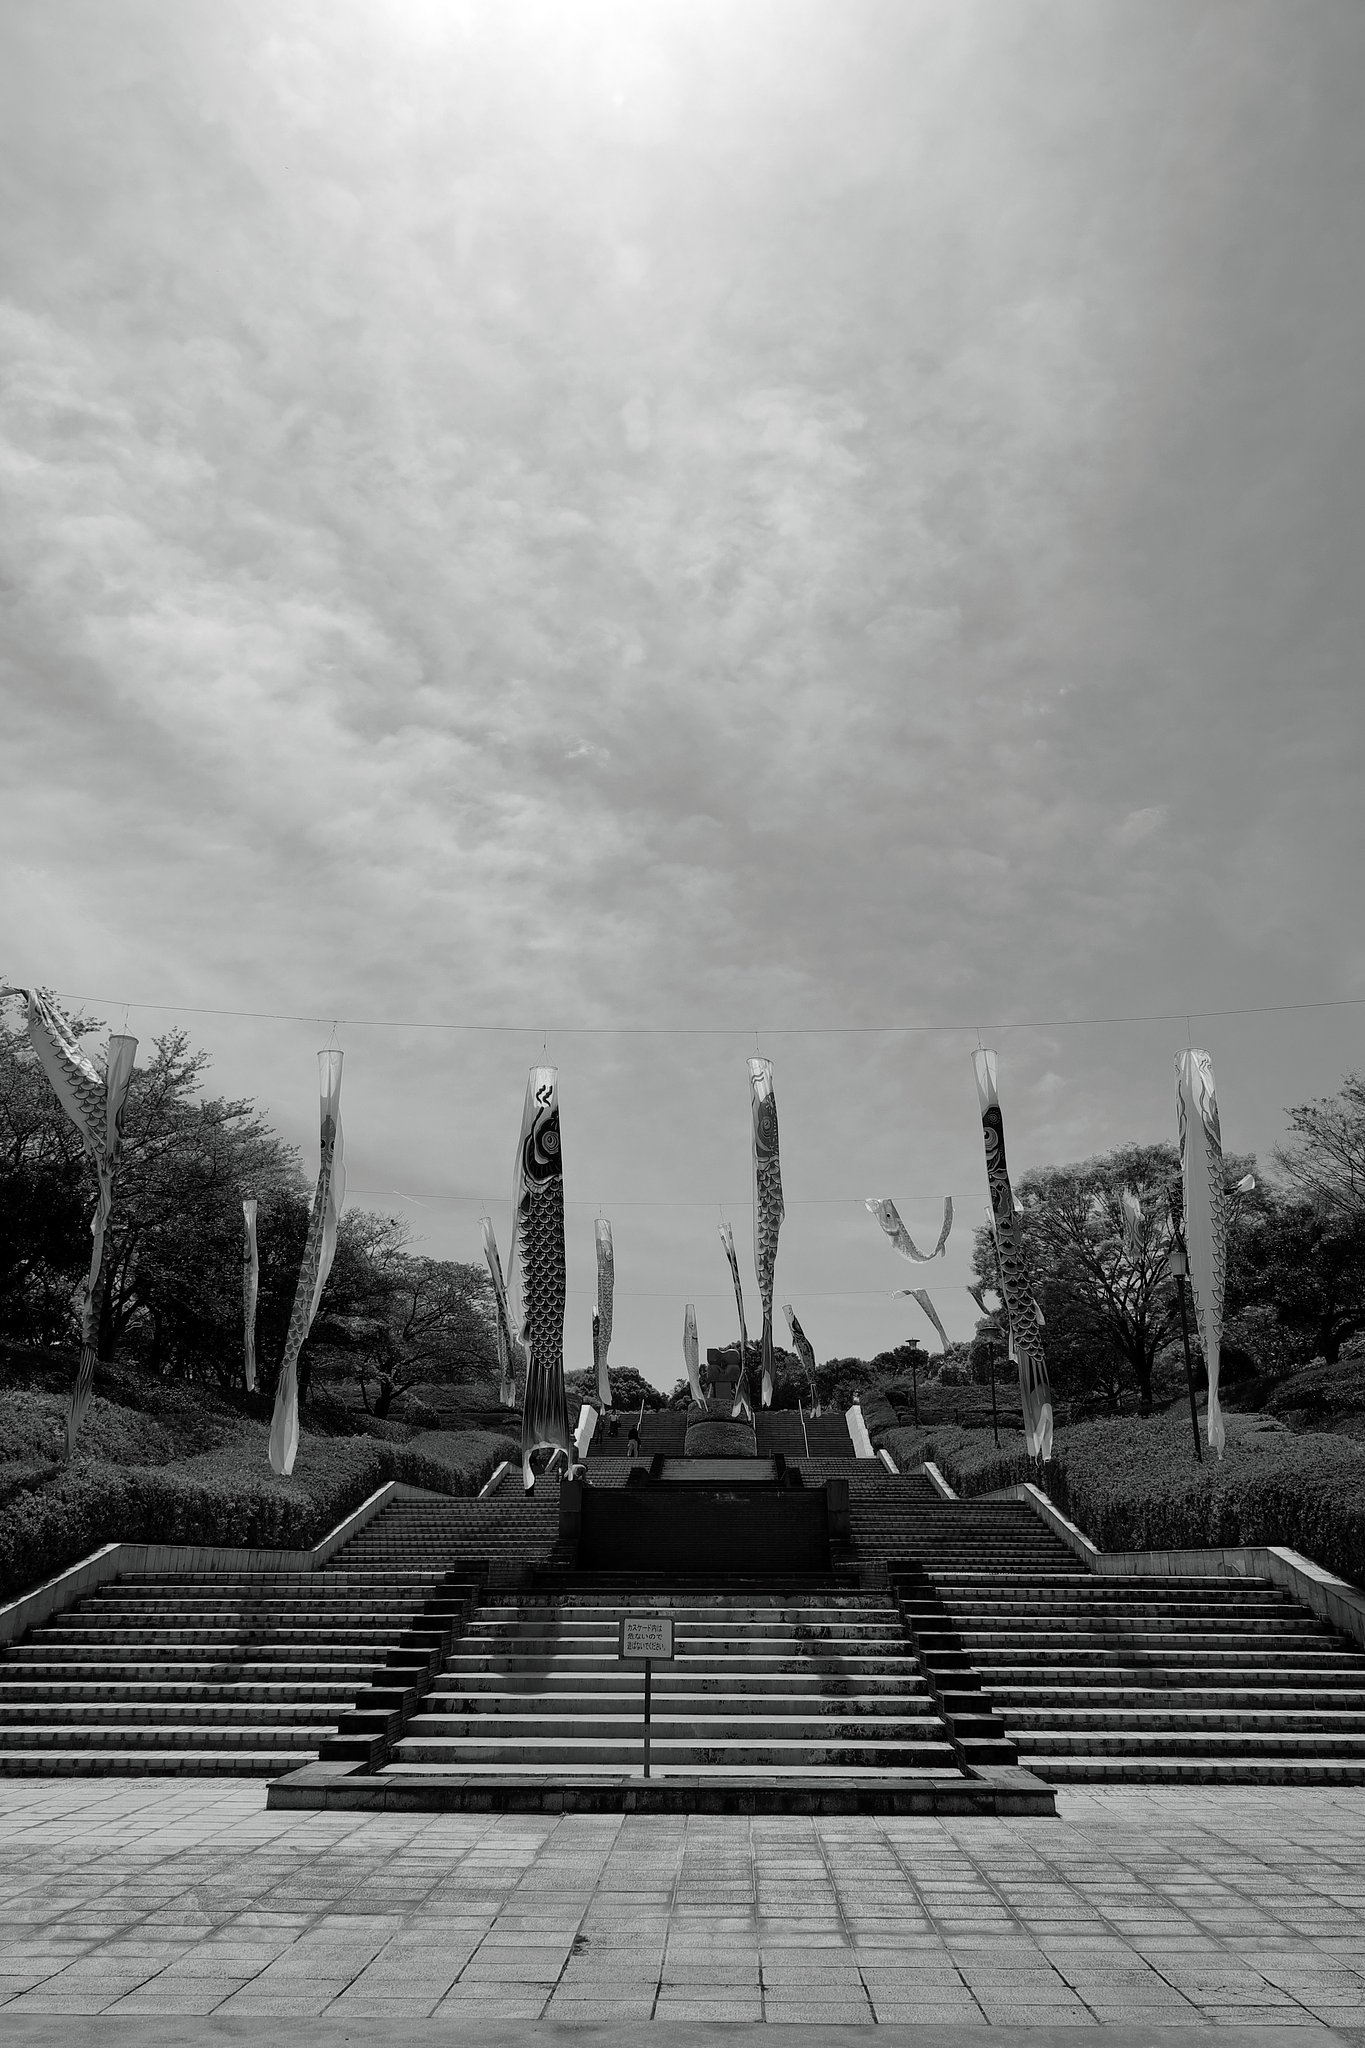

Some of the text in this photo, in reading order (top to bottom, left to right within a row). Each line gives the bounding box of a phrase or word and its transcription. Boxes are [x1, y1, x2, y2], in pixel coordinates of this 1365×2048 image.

[627, 1624, 663, 1632] カスケード内は
